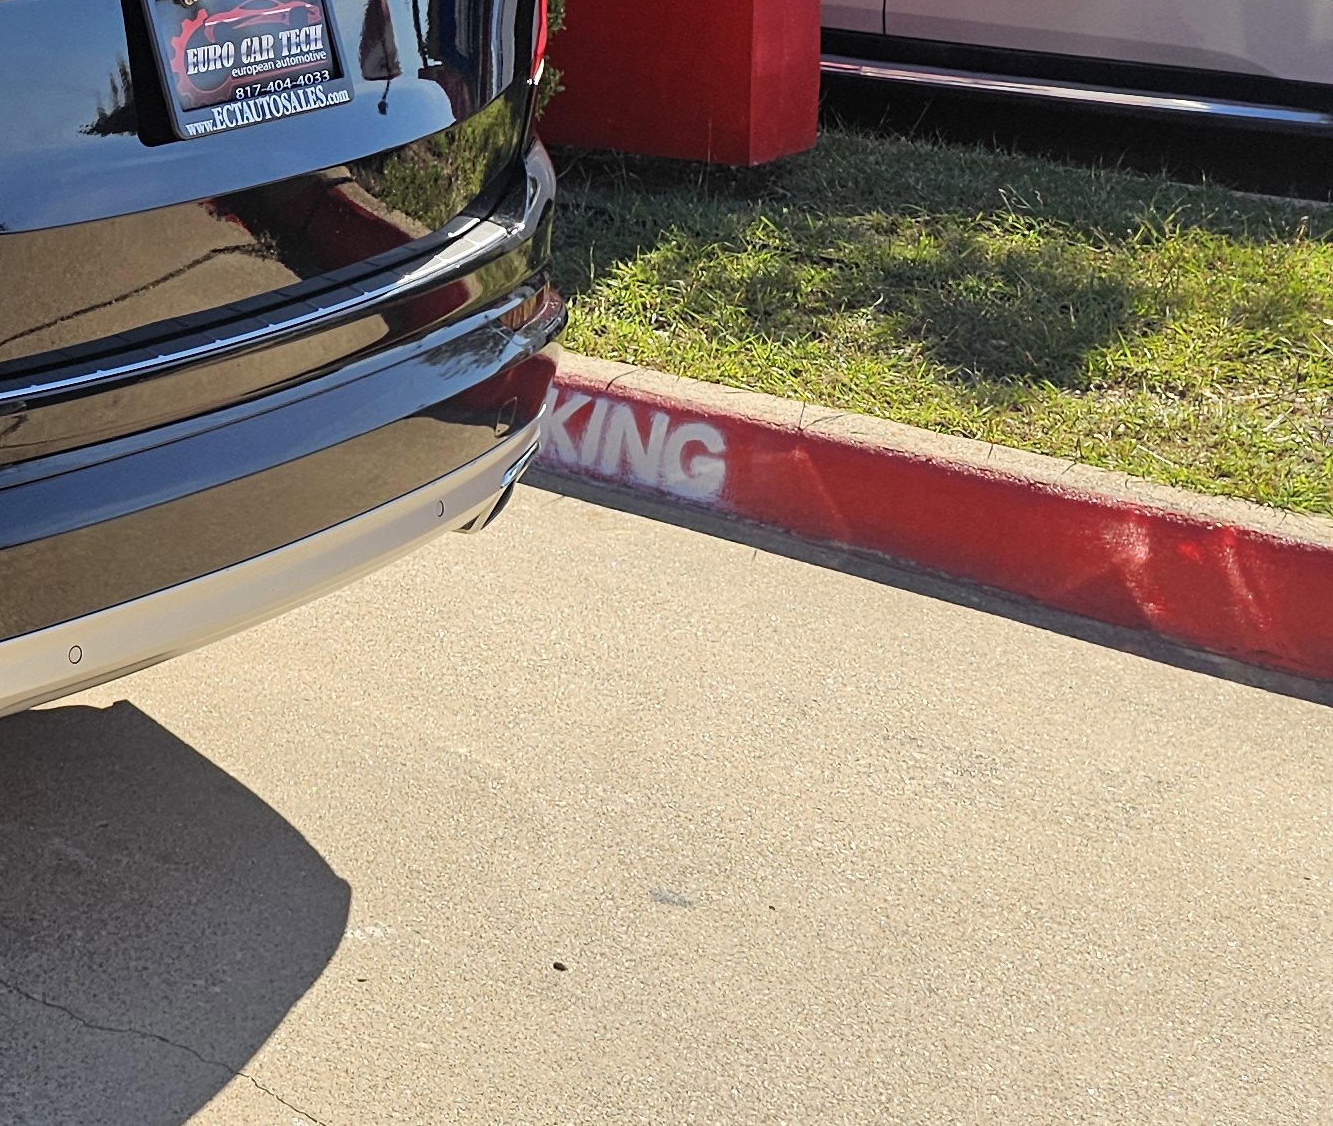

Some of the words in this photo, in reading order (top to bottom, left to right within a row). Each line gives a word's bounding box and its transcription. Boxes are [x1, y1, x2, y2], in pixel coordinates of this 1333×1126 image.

[186, 41, 235, 75] EURO
[240, 34, 275, 64] CAR
[279, 24, 324, 57] TECH
[231, 62, 275, 78] european
[275, 50, 327, 69] automotive
[185, 84, 350, 136] www.ECTAUTOSALES.com
[235, 70, 330, 100] 817-404-4033
[539, 387, 726, 496] KING
